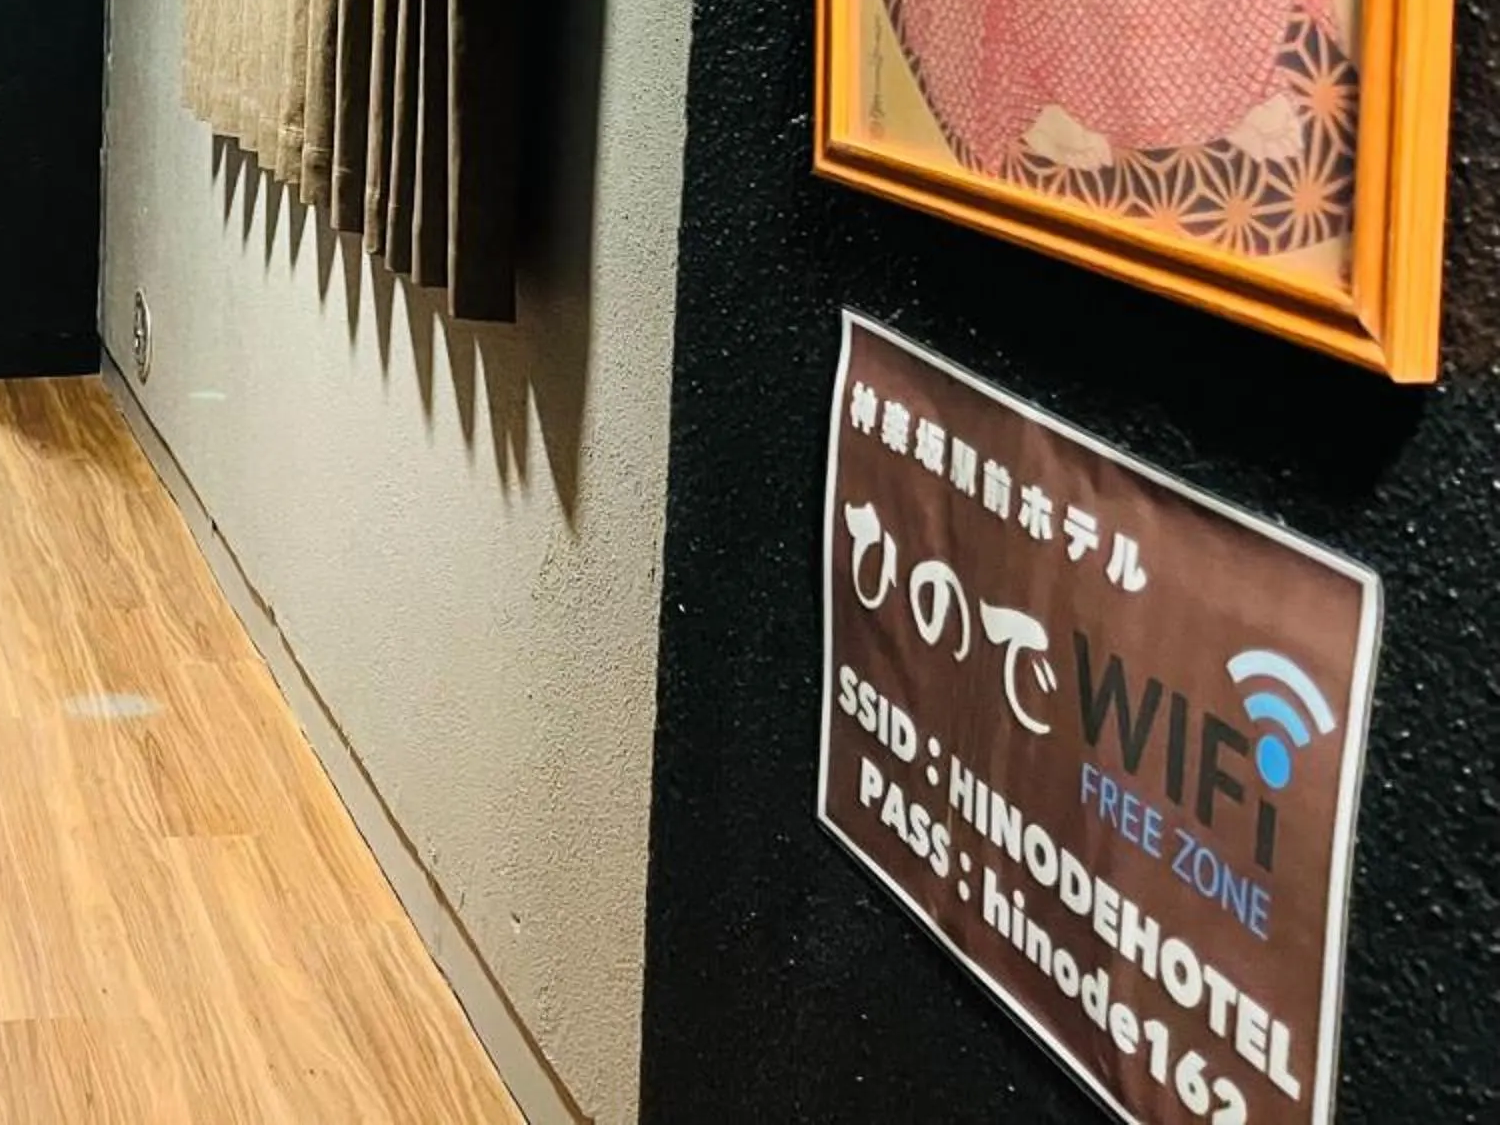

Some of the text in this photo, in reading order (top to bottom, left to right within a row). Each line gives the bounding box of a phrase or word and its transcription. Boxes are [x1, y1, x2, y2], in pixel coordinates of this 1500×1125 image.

[843, 501, 1058, 735] ひので
[1080, 762, 1271, 940] FREE ZONE
